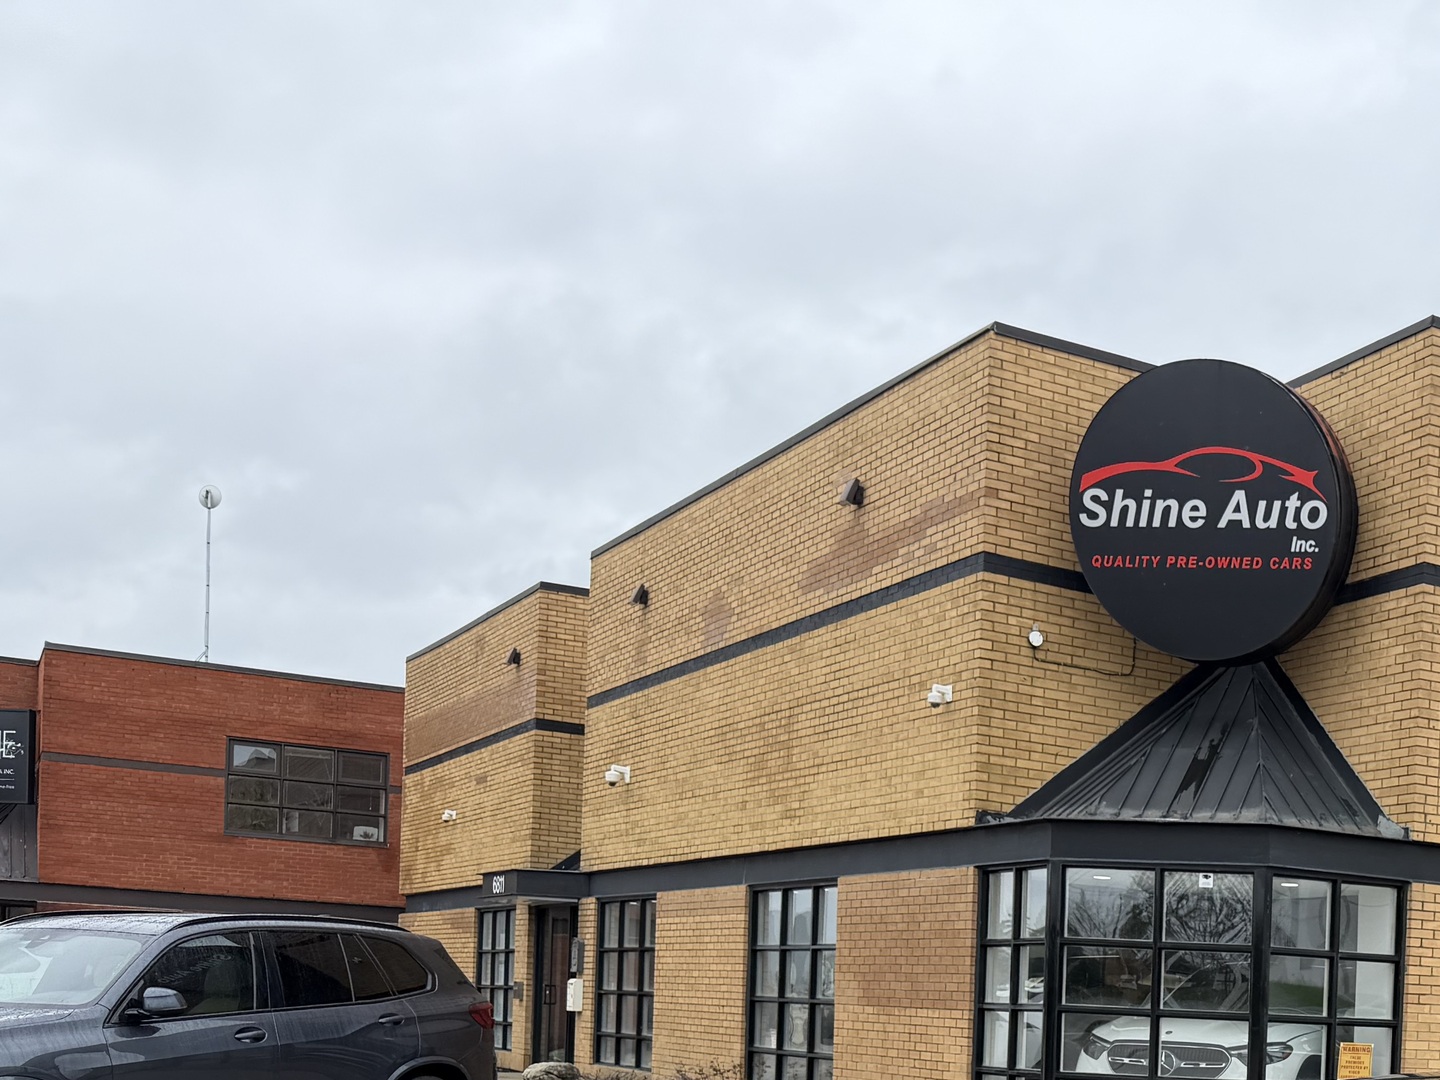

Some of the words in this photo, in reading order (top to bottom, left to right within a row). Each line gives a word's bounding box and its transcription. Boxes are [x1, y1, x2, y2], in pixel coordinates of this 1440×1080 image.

[1078, 488, 1207, 529] Shine
[1217, 489, 1328, 530] Auto
[1290, 535, 1319, 553] Inc.
[1091, 554, 1161, 569] QUALITY
[1166, 555, 1263, 570] PRE-OWNED
[1269, 556, 1313, 570] CARS
